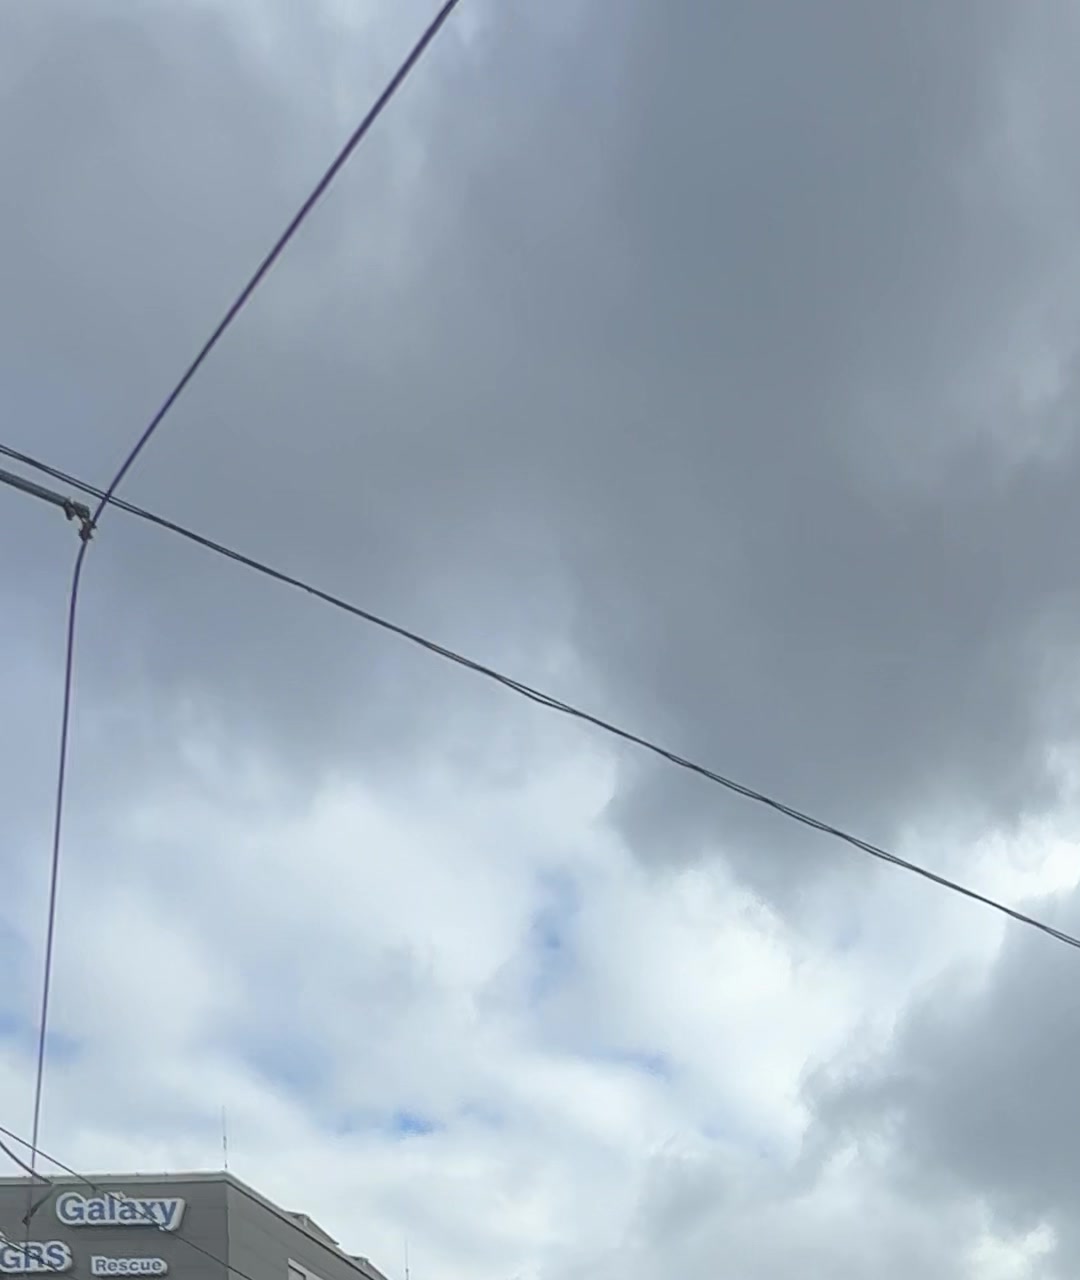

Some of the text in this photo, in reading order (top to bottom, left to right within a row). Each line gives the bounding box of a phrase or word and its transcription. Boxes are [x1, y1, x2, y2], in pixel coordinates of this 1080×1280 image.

[59, 1194, 179, 1228] Galaxy
[0, 1243, 66, 1269] GRS
[94, 1258, 163, 1273] Rescue
